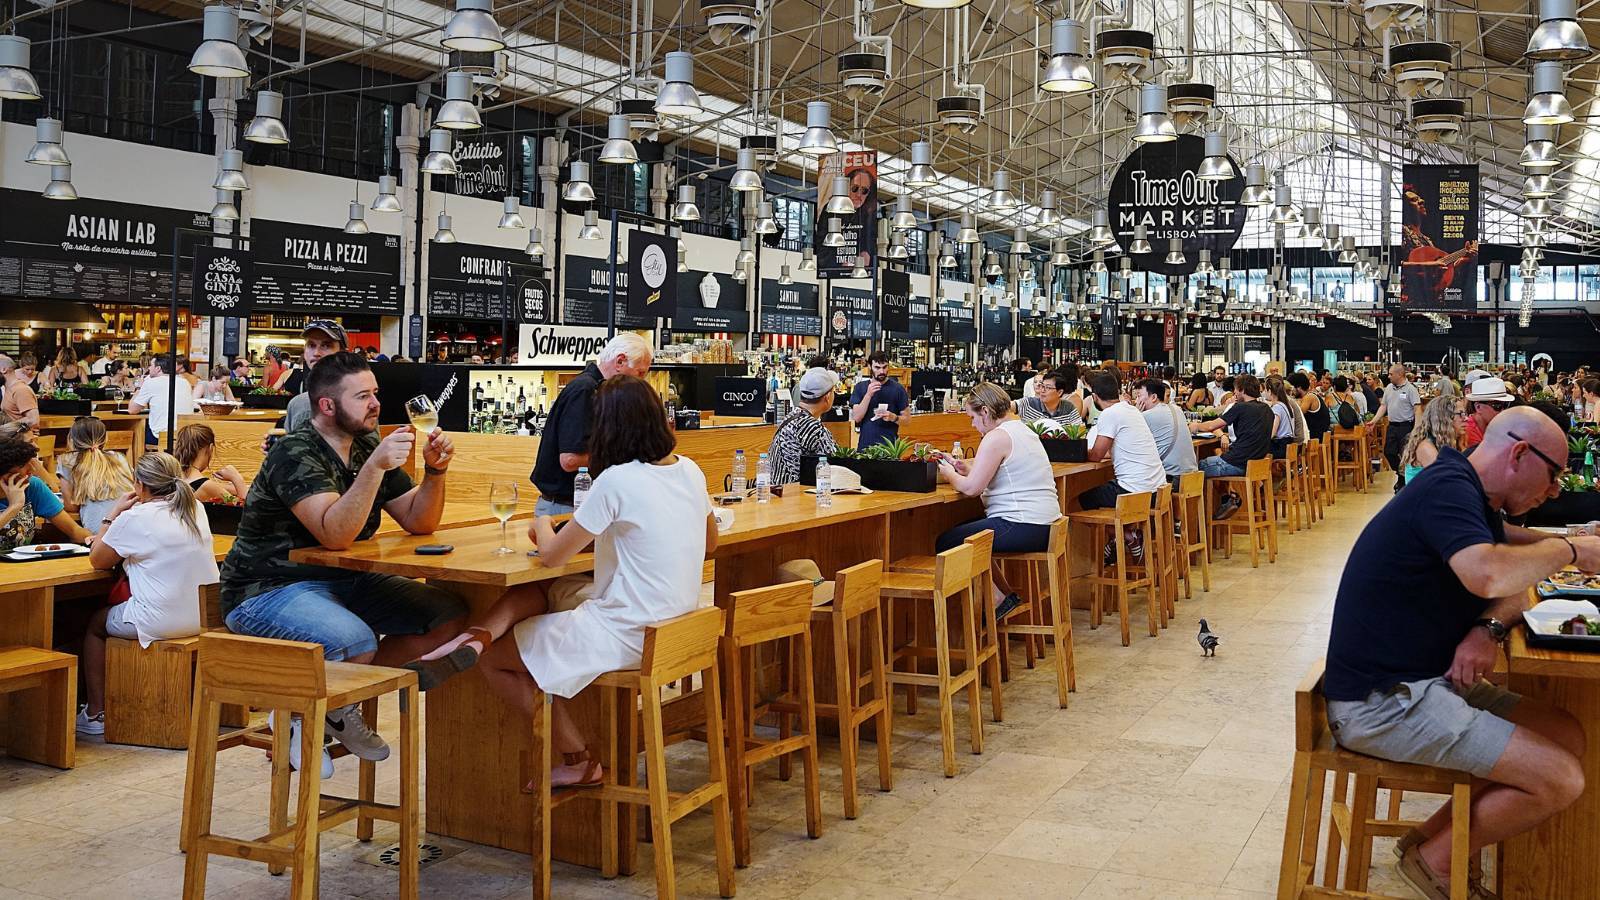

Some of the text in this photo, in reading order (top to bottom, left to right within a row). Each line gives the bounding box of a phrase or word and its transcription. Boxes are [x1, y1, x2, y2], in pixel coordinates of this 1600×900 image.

[453, 140, 503, 162] Estúdio
[1131, 170, 1219, 206] Time Out
[1119, 209, 1235, 227] MARKET
[67, 214, 157, 245] ASIAN LAB
[1156, 229, 1197, 239] LISBOA
[285, 238, 368, 265] PIZZA A PEZZI
[205, 271, 236, 284] CASA
[591, 269, 629, 288] HONOATO
[204, 281, 242, 294] GINJA
[524, 288, 544, 299] FRUTOS
[779, 289, 800, 303] SANTINI
[883, 292, 907, 308] CINCO
[524, 298, 544, 311] SECOS
[1207, 321, 1250, 332] MANTEIGARIA
[433, 371, 459, 414] hweppes
[722, 391, 755, 403] CINCO
